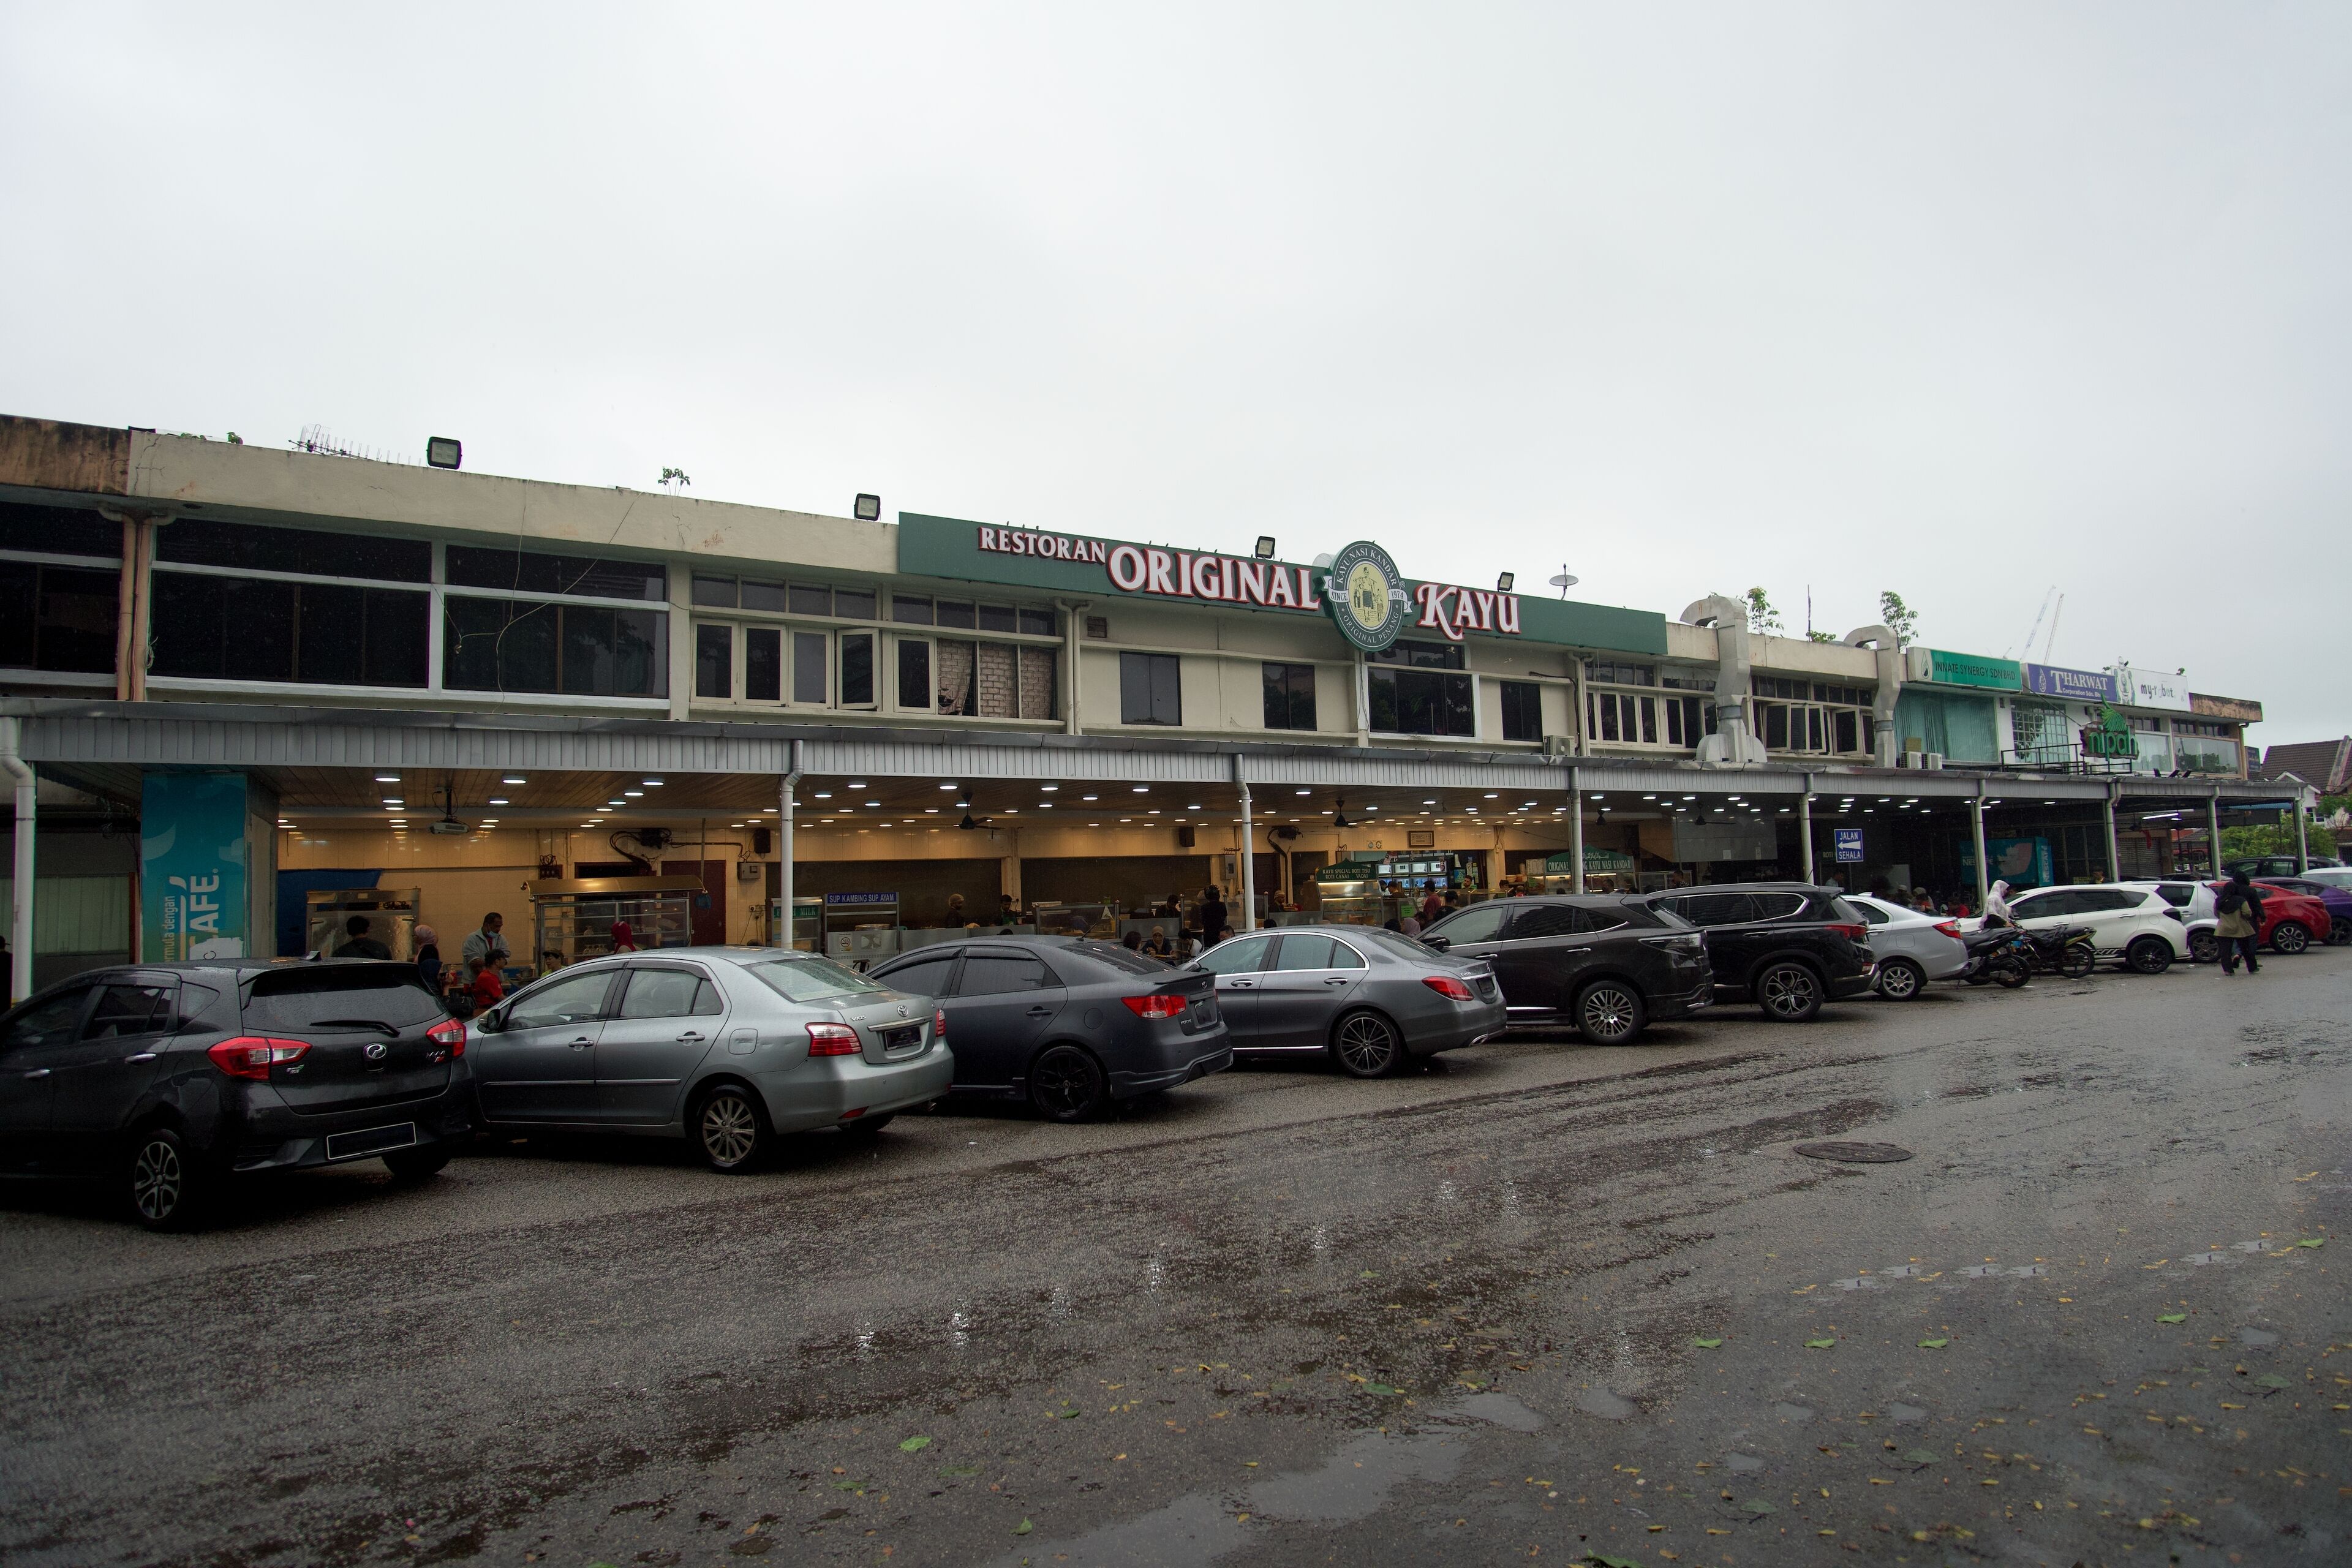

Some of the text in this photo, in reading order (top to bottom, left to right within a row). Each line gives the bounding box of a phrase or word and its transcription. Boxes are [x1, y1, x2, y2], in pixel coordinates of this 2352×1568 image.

[1336, 548, 1397, 586] KAYU NASI KANDAR
[979, 527, 1521, 641] RESTORAN ORIGINAL KAYU
[1331, 590, 1403, 601] SINCE 1974
[1343, 612, 1399, 643] ORIGINAL PENANG
[1936, 662, 2015, 680] INNATE SYNERGY SDN BHD
[2051, 670, 2107, 693] THARWAT
[2089, 725, 2137, 761] nipah
[1589, 861, 1600, 870] KAYU
[1602, 861, 1611, 869] NASI
[1613, 860, 1630, 869] KANDAR
[1839, 851, 1861, 859] SEHALA
[162, 895, 178, 930] dengan
